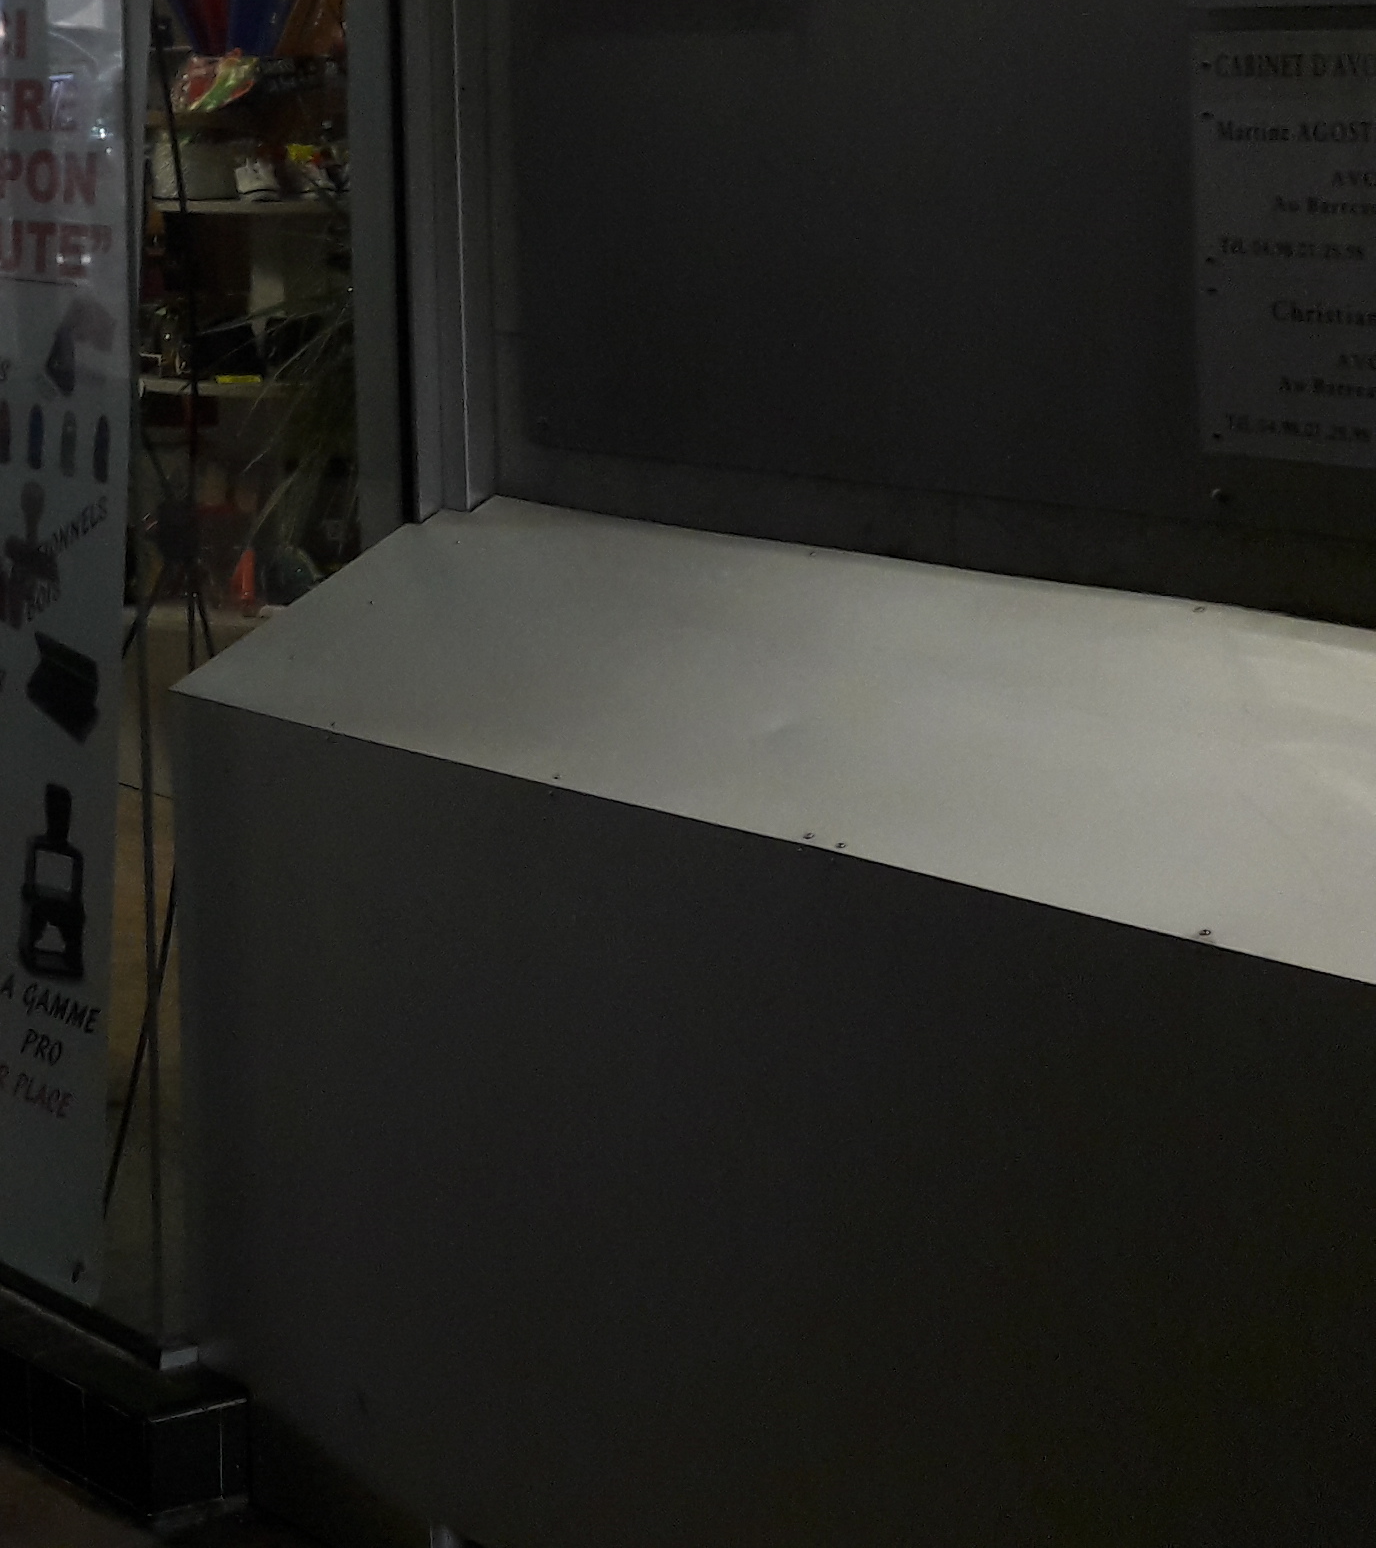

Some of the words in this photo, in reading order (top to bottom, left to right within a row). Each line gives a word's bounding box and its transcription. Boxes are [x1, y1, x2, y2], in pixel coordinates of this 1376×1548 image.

[1215, 53, 1303, 78] CABINET
[1298, 121, 1376, 143] AGOST
[22, 981, 101, 1034] GAMME
[20, 1028, 64, 1067] PRO
[13, 1071, 78, 1120] PLACE
